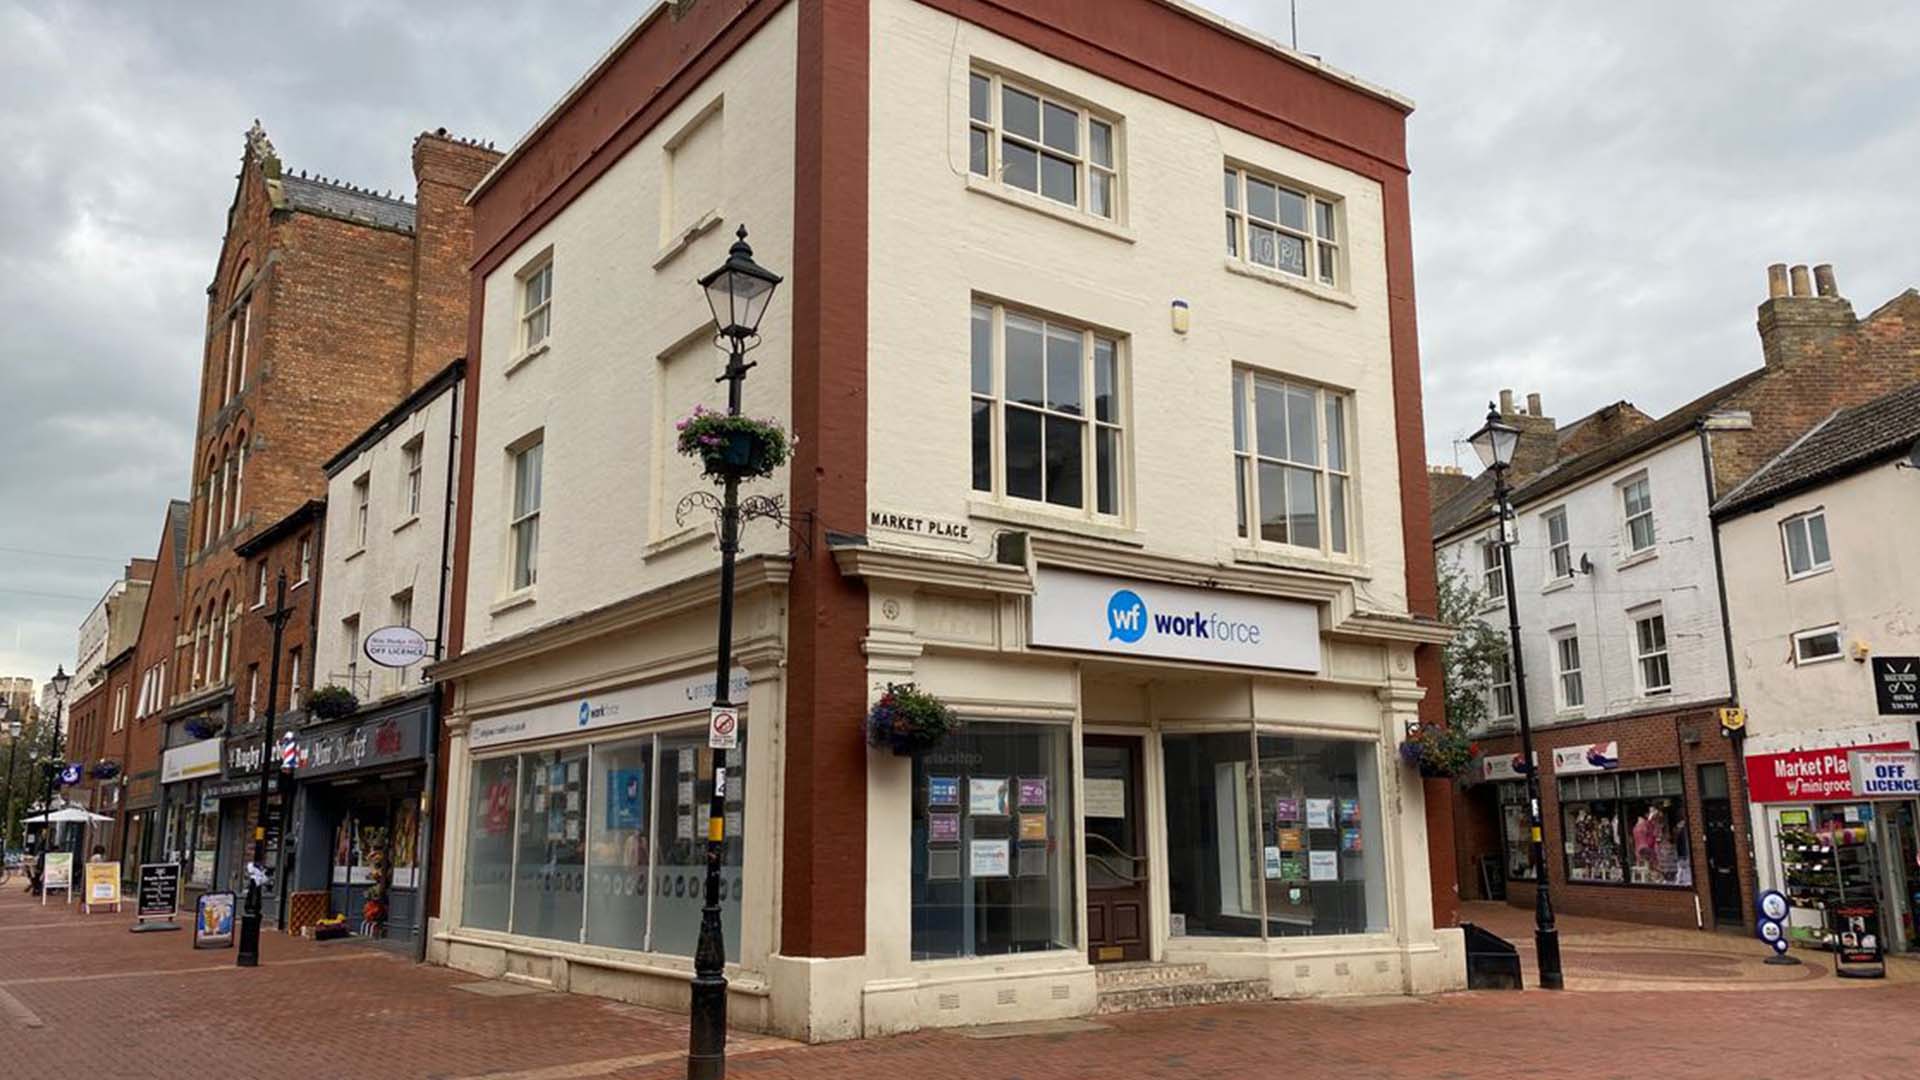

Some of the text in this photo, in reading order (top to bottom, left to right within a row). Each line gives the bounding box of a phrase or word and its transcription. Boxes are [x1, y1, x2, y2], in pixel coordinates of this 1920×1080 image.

[871, 512, 968, 538] MARKET PLACE
[1113, 604, 1140, 631] wf
[1155, 611, 1260, 644] workforce
[1774, 754, 1849, 778] Market Pla
[1875, 764, 1905, 778] OFF
[1823, 780, 1852, 797] groce
[1865, 779, 1920, 792] LICENCE
